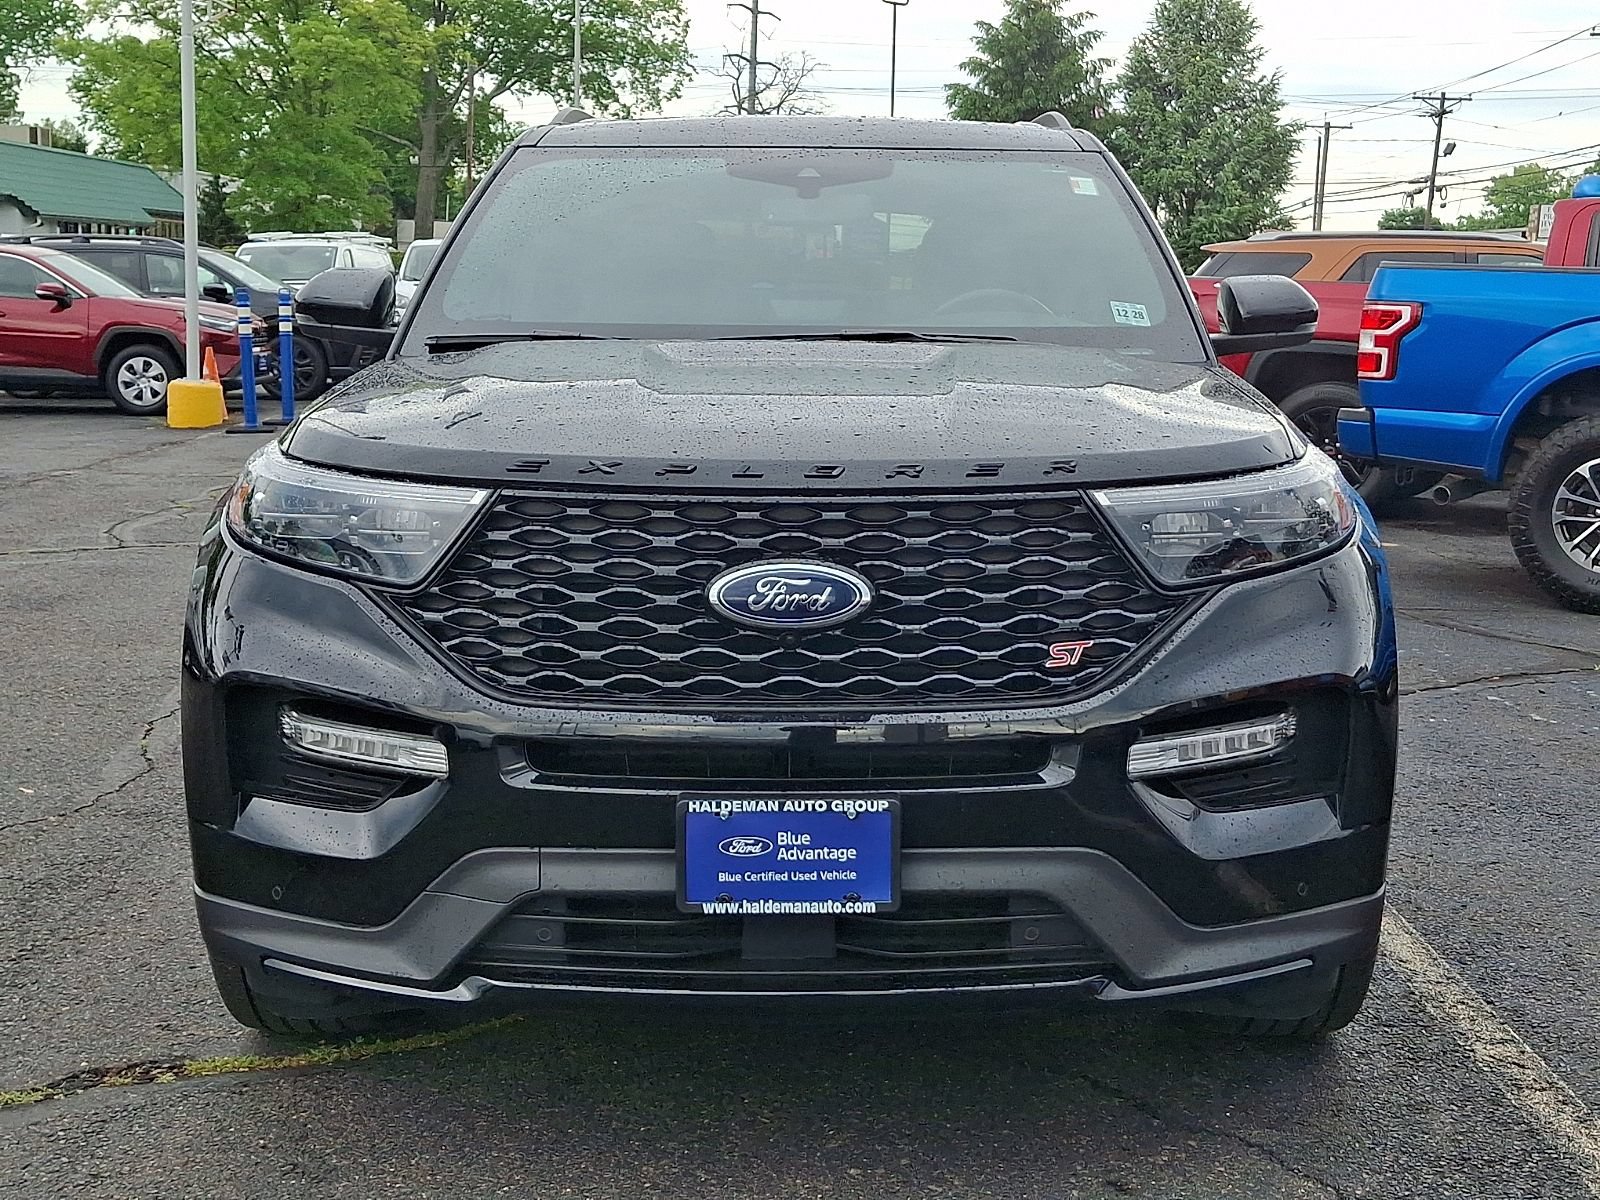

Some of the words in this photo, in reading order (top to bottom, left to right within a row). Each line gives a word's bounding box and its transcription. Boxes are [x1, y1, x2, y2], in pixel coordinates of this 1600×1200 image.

[1115, 308, 1129, 318] 12
[1131, 310, 1144, 320] 28
[505, 459, 1077, 479] EXPLORER
[747, 576, 833, 612] Ford
[1045, 640, 1094, 668] ST
[688, 800, 779, 813] HALDEMAN
[782, 799, 828, 812] AUTO
[831, 799, 889, 813] GROUP
[777, 831, 811, 846] Blue
[729, 839, 763, 854] Ford
[777, 847, 857, 862] Advantage
[718, 872, 741, 882] Blue
[744, 871, 788, 882] Certified
[791, 871, 817, 881] Used
[820, 870, 857, 880] Vehicle
[702, 899, 876, 915] www.haldemanauto.com
